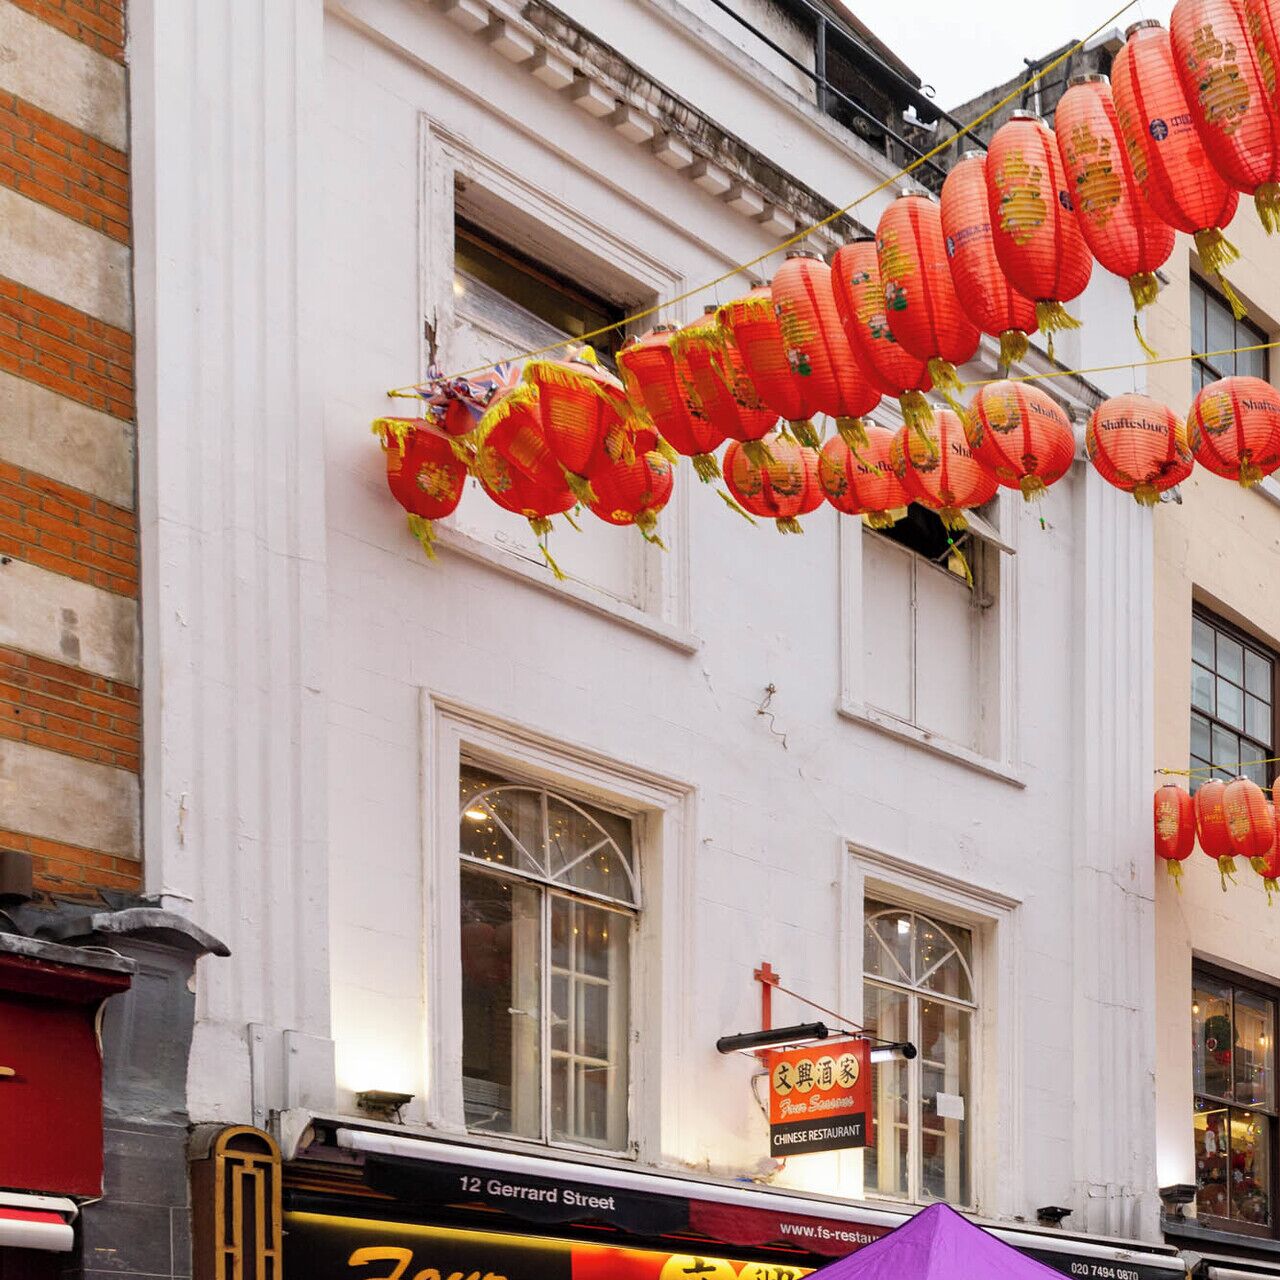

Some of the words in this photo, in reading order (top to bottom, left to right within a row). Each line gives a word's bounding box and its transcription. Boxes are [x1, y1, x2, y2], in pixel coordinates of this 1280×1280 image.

[1101, 417, 1169, 436] Shaftesbury
[775, 1058, 856, 1090] 文興酒家
[780, 1098, 807, 1119] Four
[808, 1094, 855, 1113] Seasons
[773, 1131, 807, 1146] CHINESE
[808, 1124, 861, 1141] RESTAURANT
[458, 1175, 482, 1192] 12
[487, 1179, 559, 1204] Gerrard
[562, 1189, 616, 1212] Street
[1071, 1262, 1089, 1276] 020
[1090, 1265, 1115, 1280] 7494
